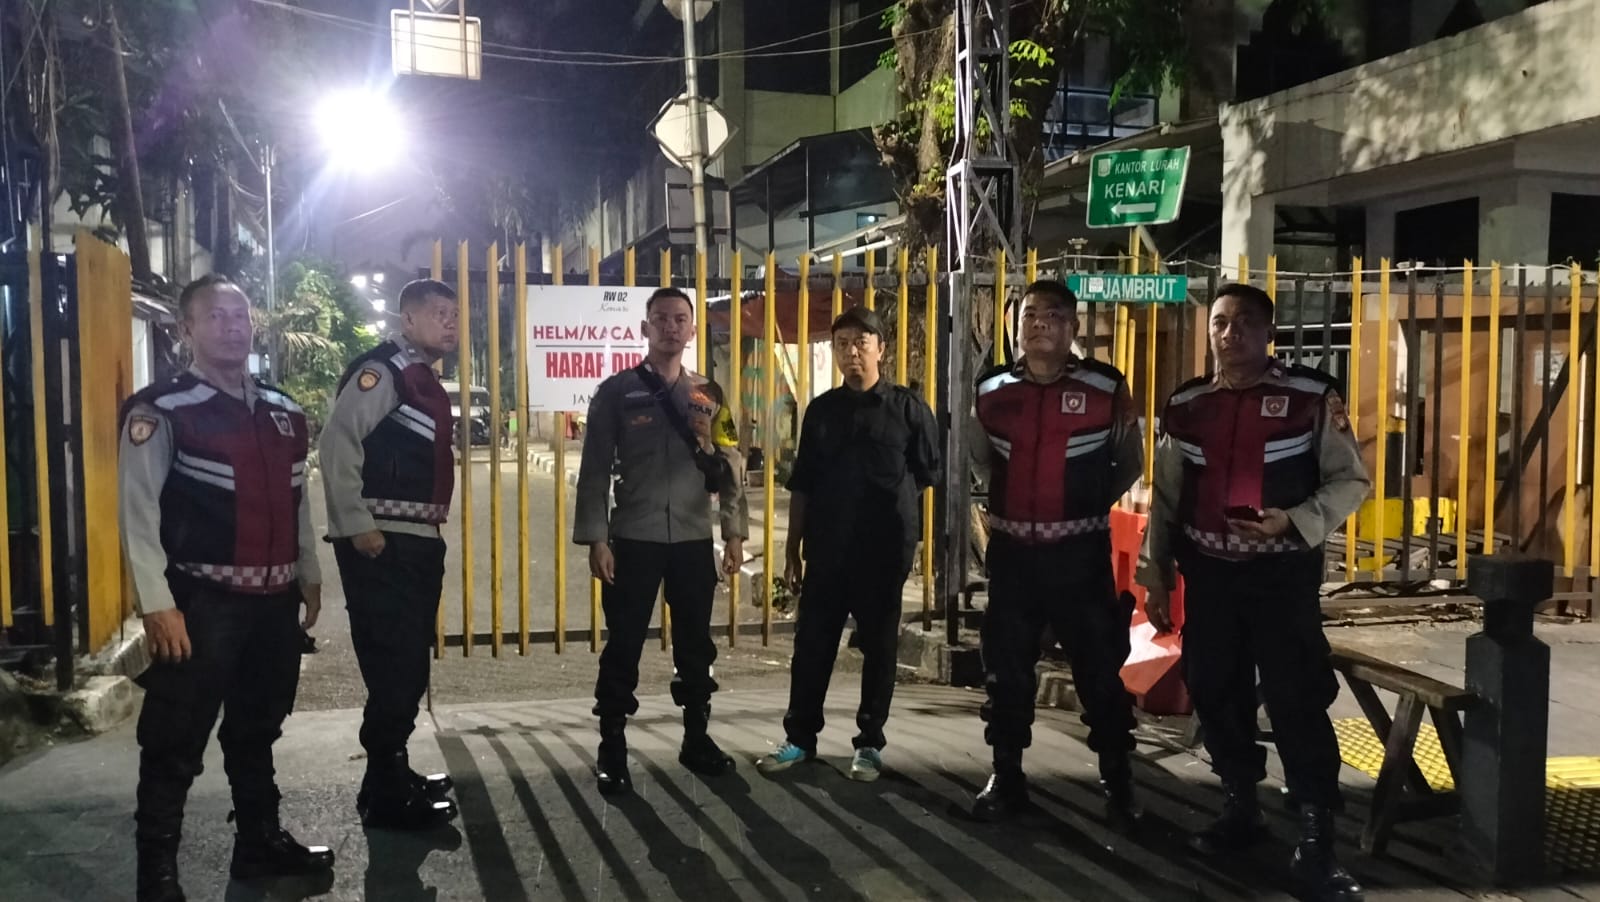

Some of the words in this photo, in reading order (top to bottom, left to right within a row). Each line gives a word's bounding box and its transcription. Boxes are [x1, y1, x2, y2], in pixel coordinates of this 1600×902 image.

[1115, 160, 1146, 175] KANTOR
[1150, 158, 1180, 172] LURAH
[1104, 179, 1166, 199] KENARI
[603, 291, 617, 302] RW
[617, 291, 628, 302] 02
[1102, 278, 1177, 300] JAMBRUT
[533, 325, 635, 341] HELM/KACA
